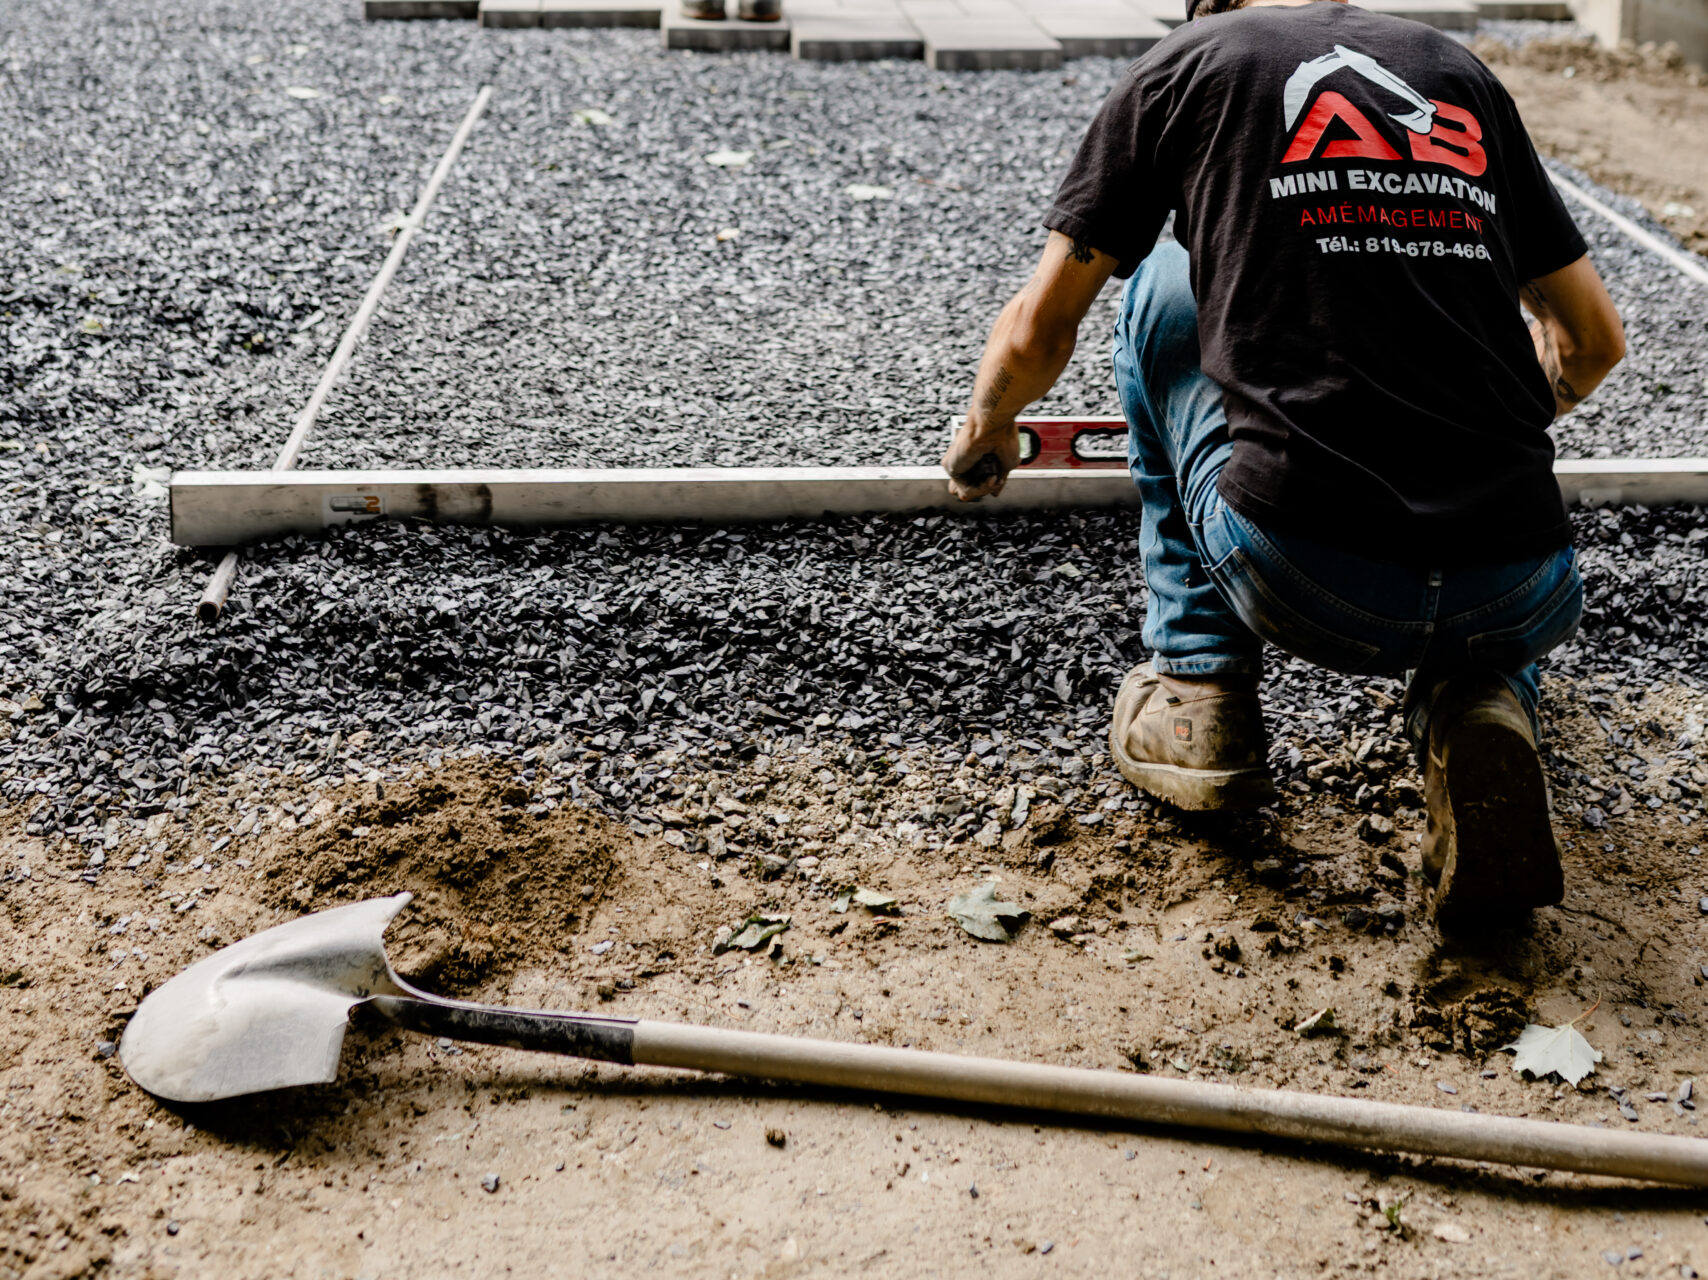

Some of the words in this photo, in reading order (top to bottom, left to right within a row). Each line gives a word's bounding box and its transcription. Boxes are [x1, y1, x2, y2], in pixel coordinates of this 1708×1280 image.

[1280, 90, 1488, 177] AB
[1269, 170, 1338, 199] MINI
[1347, 169, 1497, 215] EXCAVATION
[1365, 237, 1492, 261] 819-678-466
